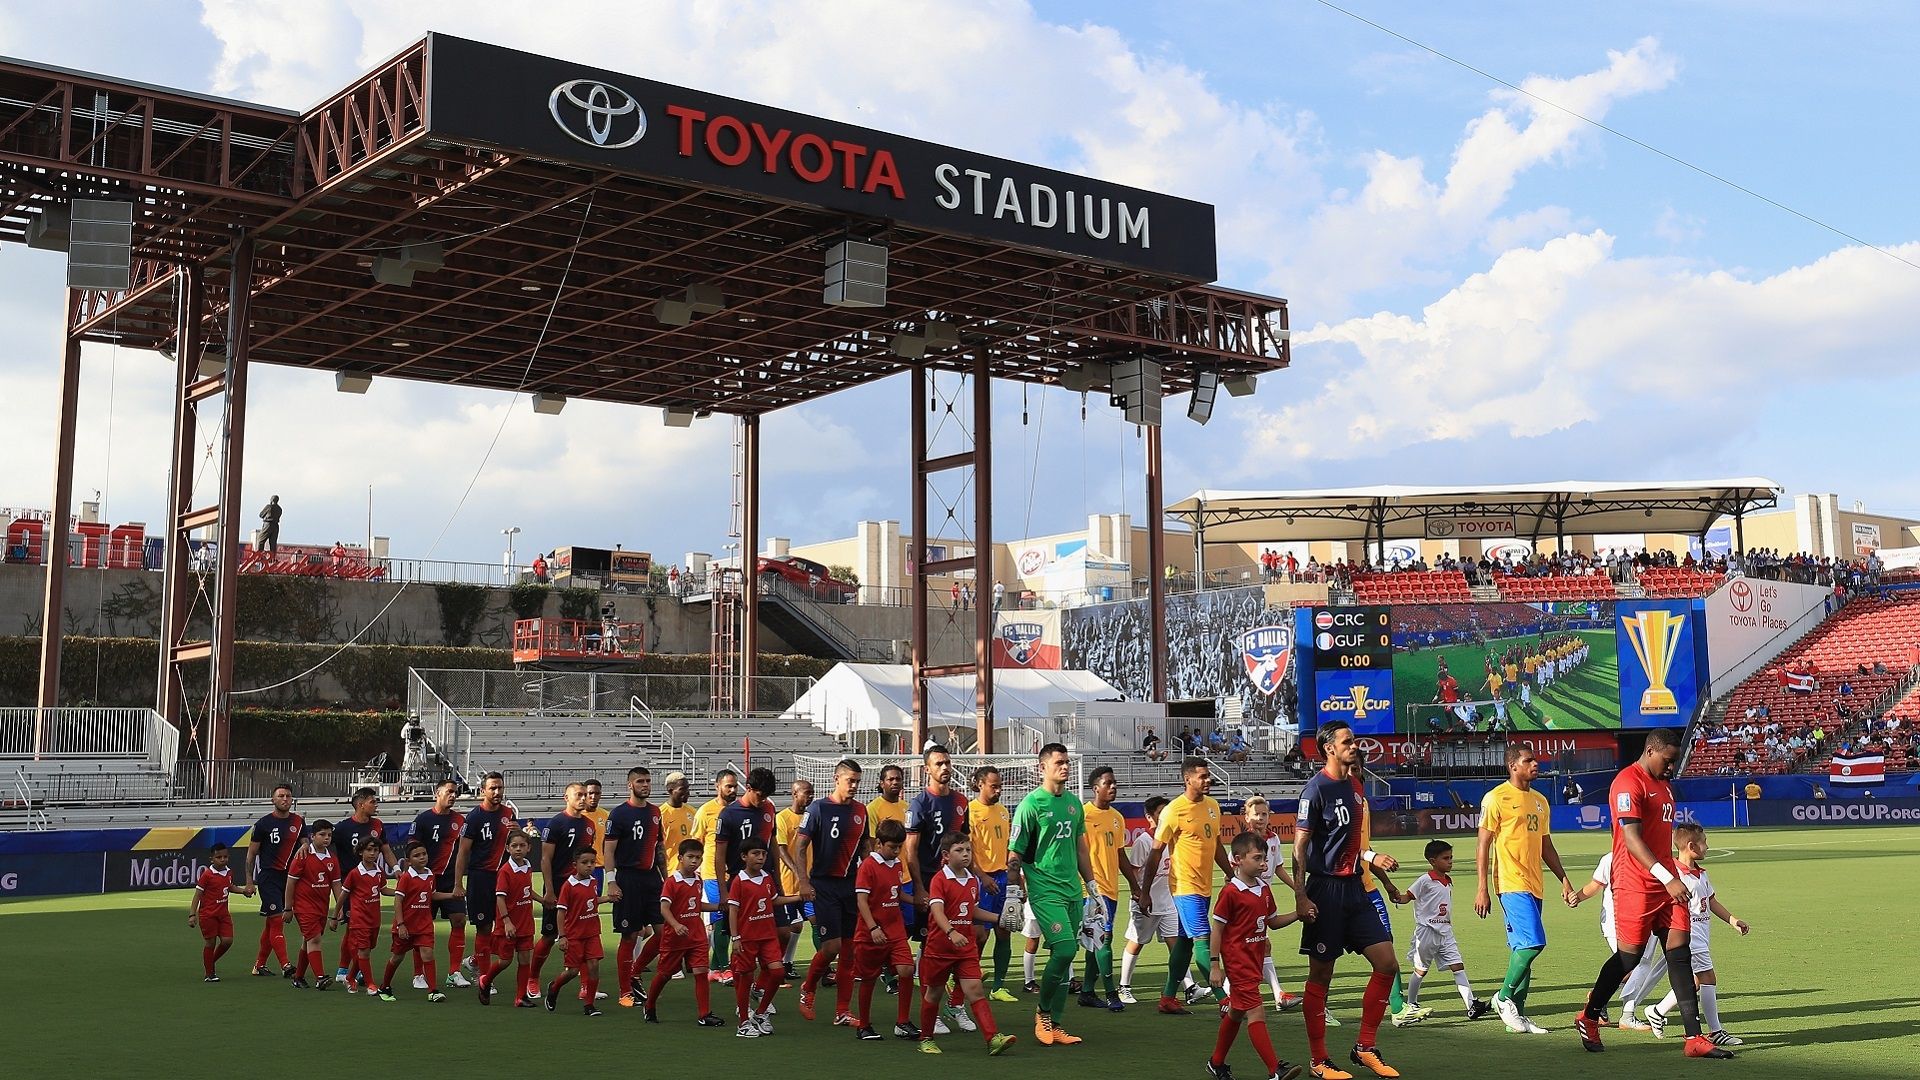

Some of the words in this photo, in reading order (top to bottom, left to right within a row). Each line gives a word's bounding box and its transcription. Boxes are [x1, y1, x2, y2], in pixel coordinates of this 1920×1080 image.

[666, 104, 906, 200] TOYOTA
[934, 162, 1151, 249] STADIUM
[1457, 521, 1514, 532] TOYOTA
[1760, 584, 1778, 599] Let's
[1760, 599, 1772, 613] Go
[1334, 613, 1365, 626] CRC
[1379, 613, 1388, 626] 0
[1729, 615, 1757, 627] TOYOTA
[1245, 633, 1256, 651] FC
[1258, 630, 1288, 648] DALLAS
[1334, 634, 1365, 647] GUF
[1380, 634, 1389, 647] 0
[1340, 654, 1370, 667] 0:00
[1320, 699, 1356, 711] GOLD
[1334, 805, 1350, 827] 10
[1662, 802, 1674, 823] 22
[1792, 804, 1920, 820] GOLDCUP.ORG
[680, 823, 688, 837] 9
[830, 822, 840, 839] 6
[934, 817, 944, 835] 3
[1055, 820, 1072, 840] 23
[1266, 822, 1294, 838] Sprint
[1526, 813, 1539, 832] 23
[269, 831, 281, 844] 15
[431, 828, 440, 842] 4
[480, 826, 493, 841] 14
[631, 825, 645, 841] 19
[739, 823, 753, 840] 17
[994, 824, 1003, 840] 11
[1105, 830, 1114, 847] 10
[1203, 823, 1212, 839] 8
[567, 832, 576, 848] 7
